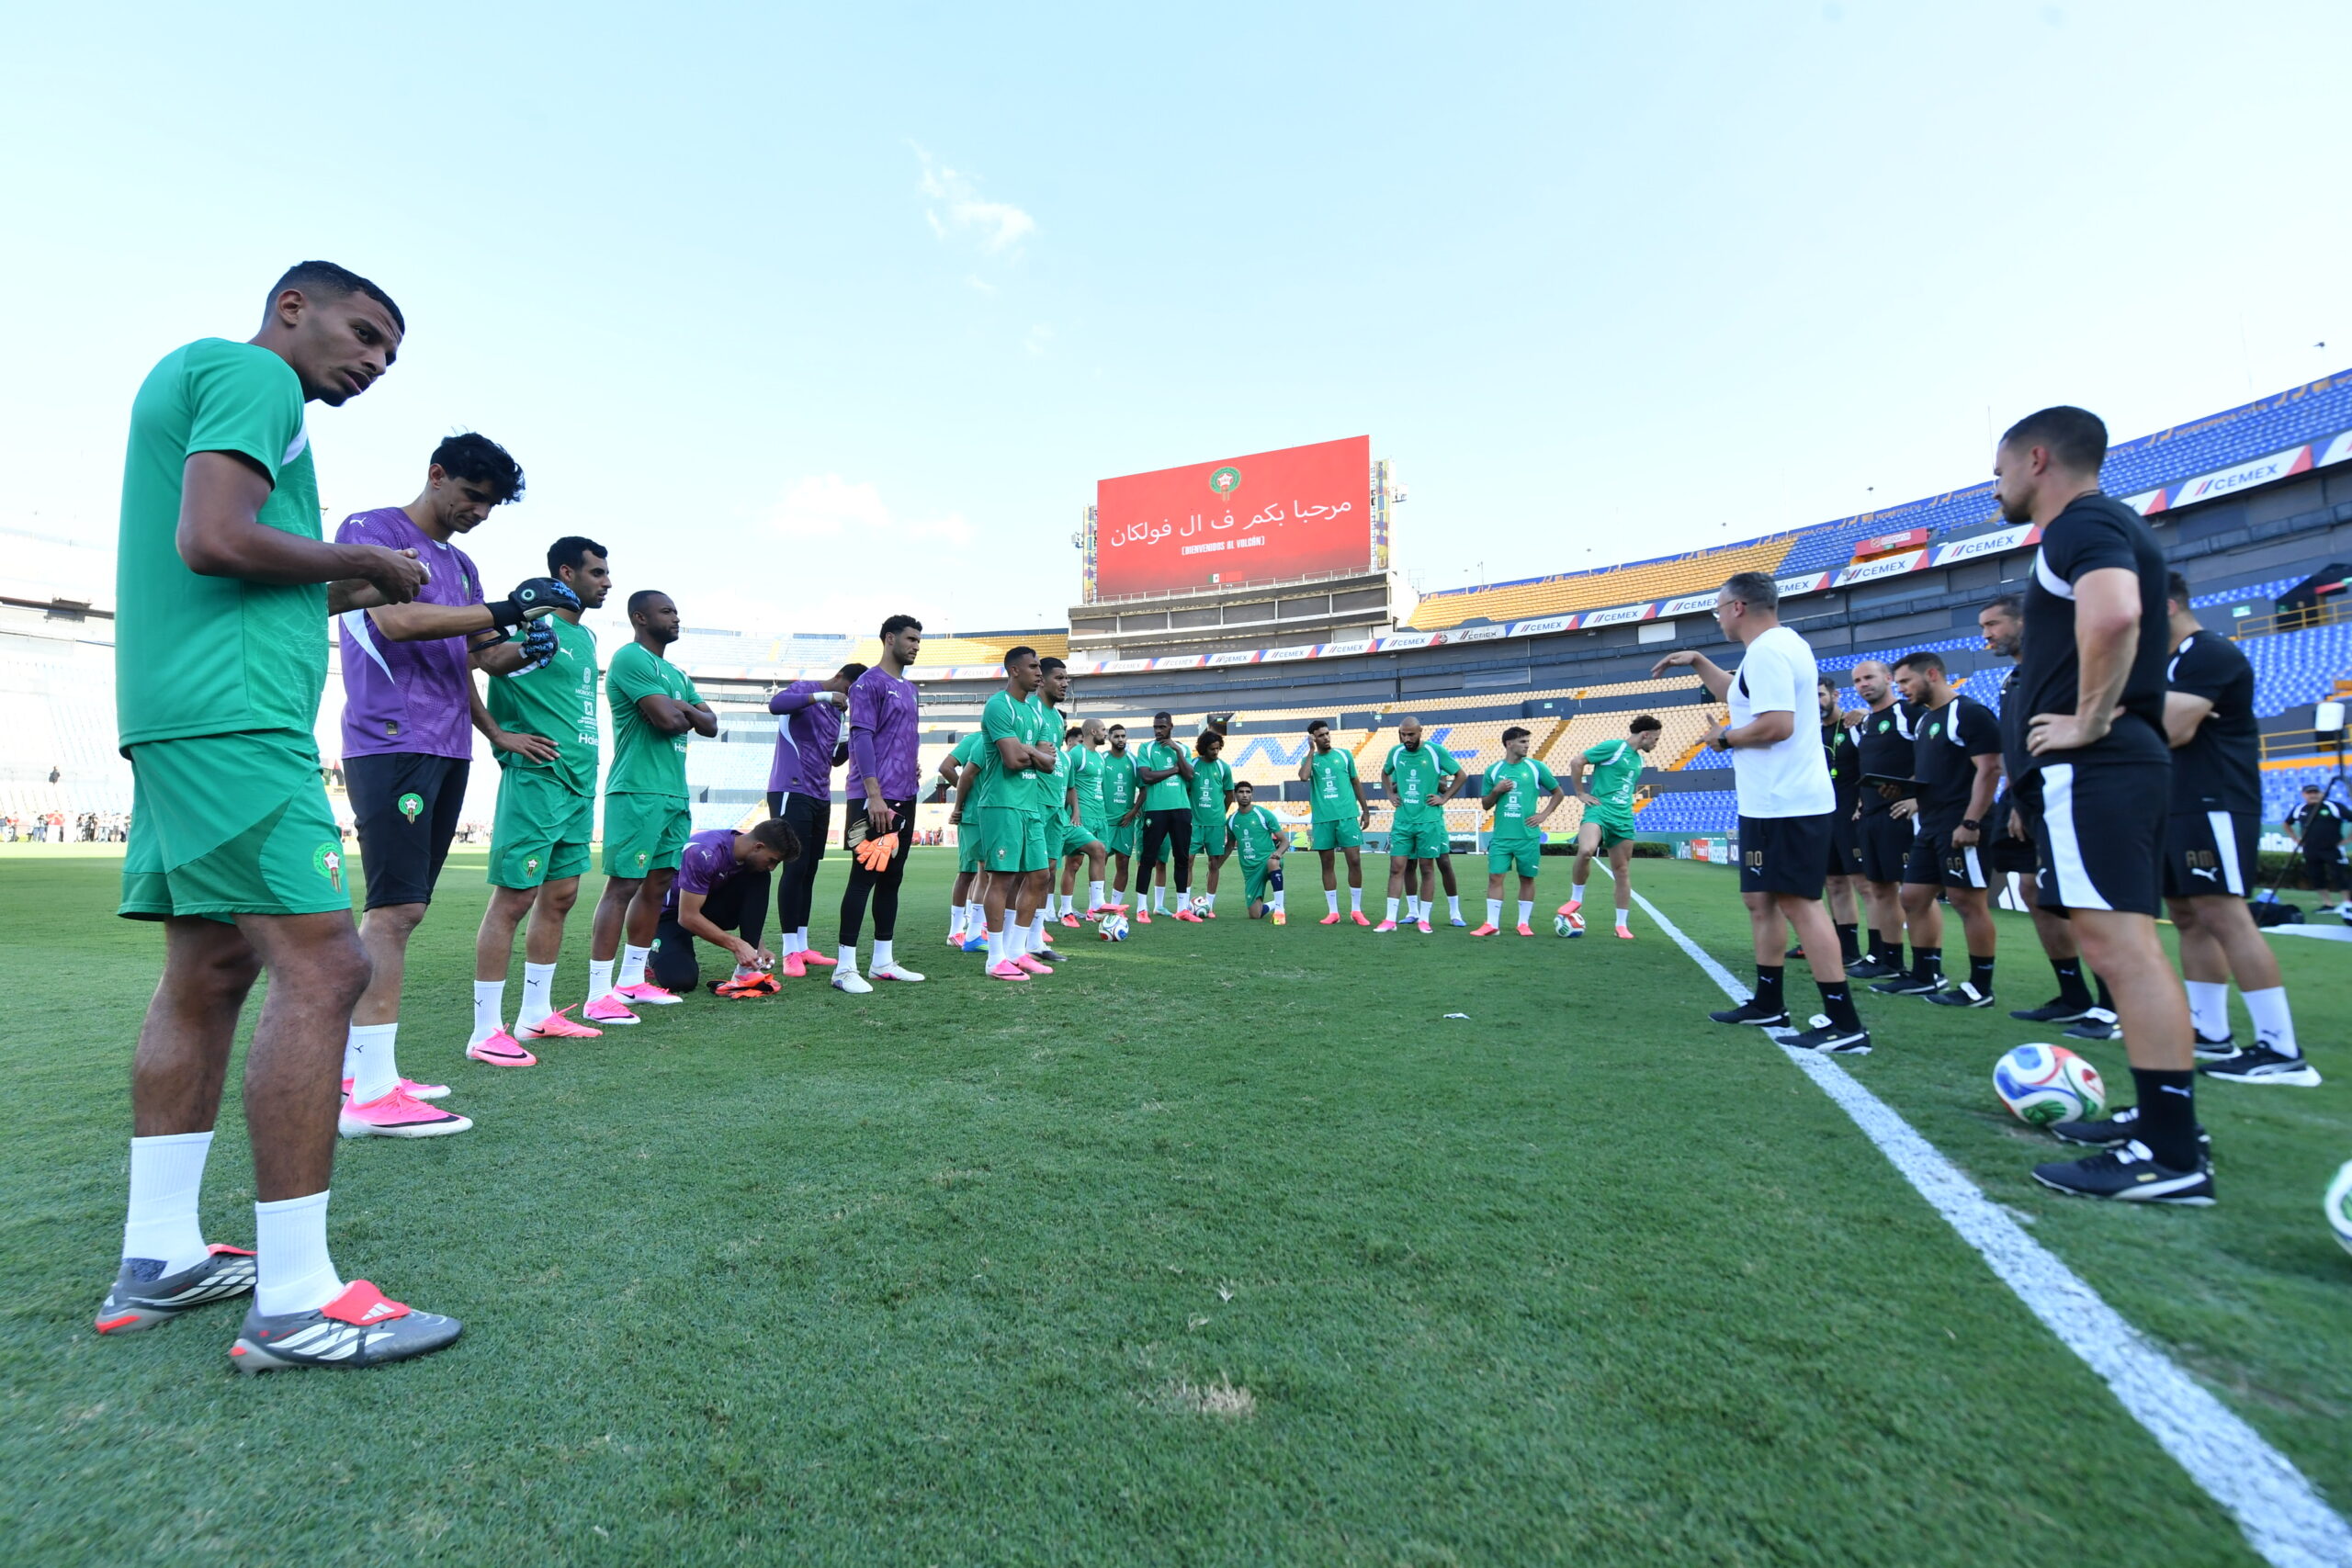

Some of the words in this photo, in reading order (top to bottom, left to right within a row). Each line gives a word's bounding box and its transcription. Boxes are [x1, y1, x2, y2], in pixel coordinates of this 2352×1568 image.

[2213, 463, 2278, 490] CEMEX
[1242, 502, 1285, 530] بكم
[1294, 500, 1351, 524] مرحبا
[1111, 518, 1171, 547] فولكان
[1965, 535, 2015, 554] CEMEX
[1862, 559, 1905, 577] CEMEX
[1778, 580, 1810, 593] EMEX
[1603, 610, 1638, 623] CEMEX
[1530, 622, 1562, 632] CEMEX
[1336, 643, 1363, 653] CEMEX
[1397, 637, 1426, 647] CEMEX
[1278, 649, 1305, 659] CEMEX
[1022, 772, 1037, 780] Haie
